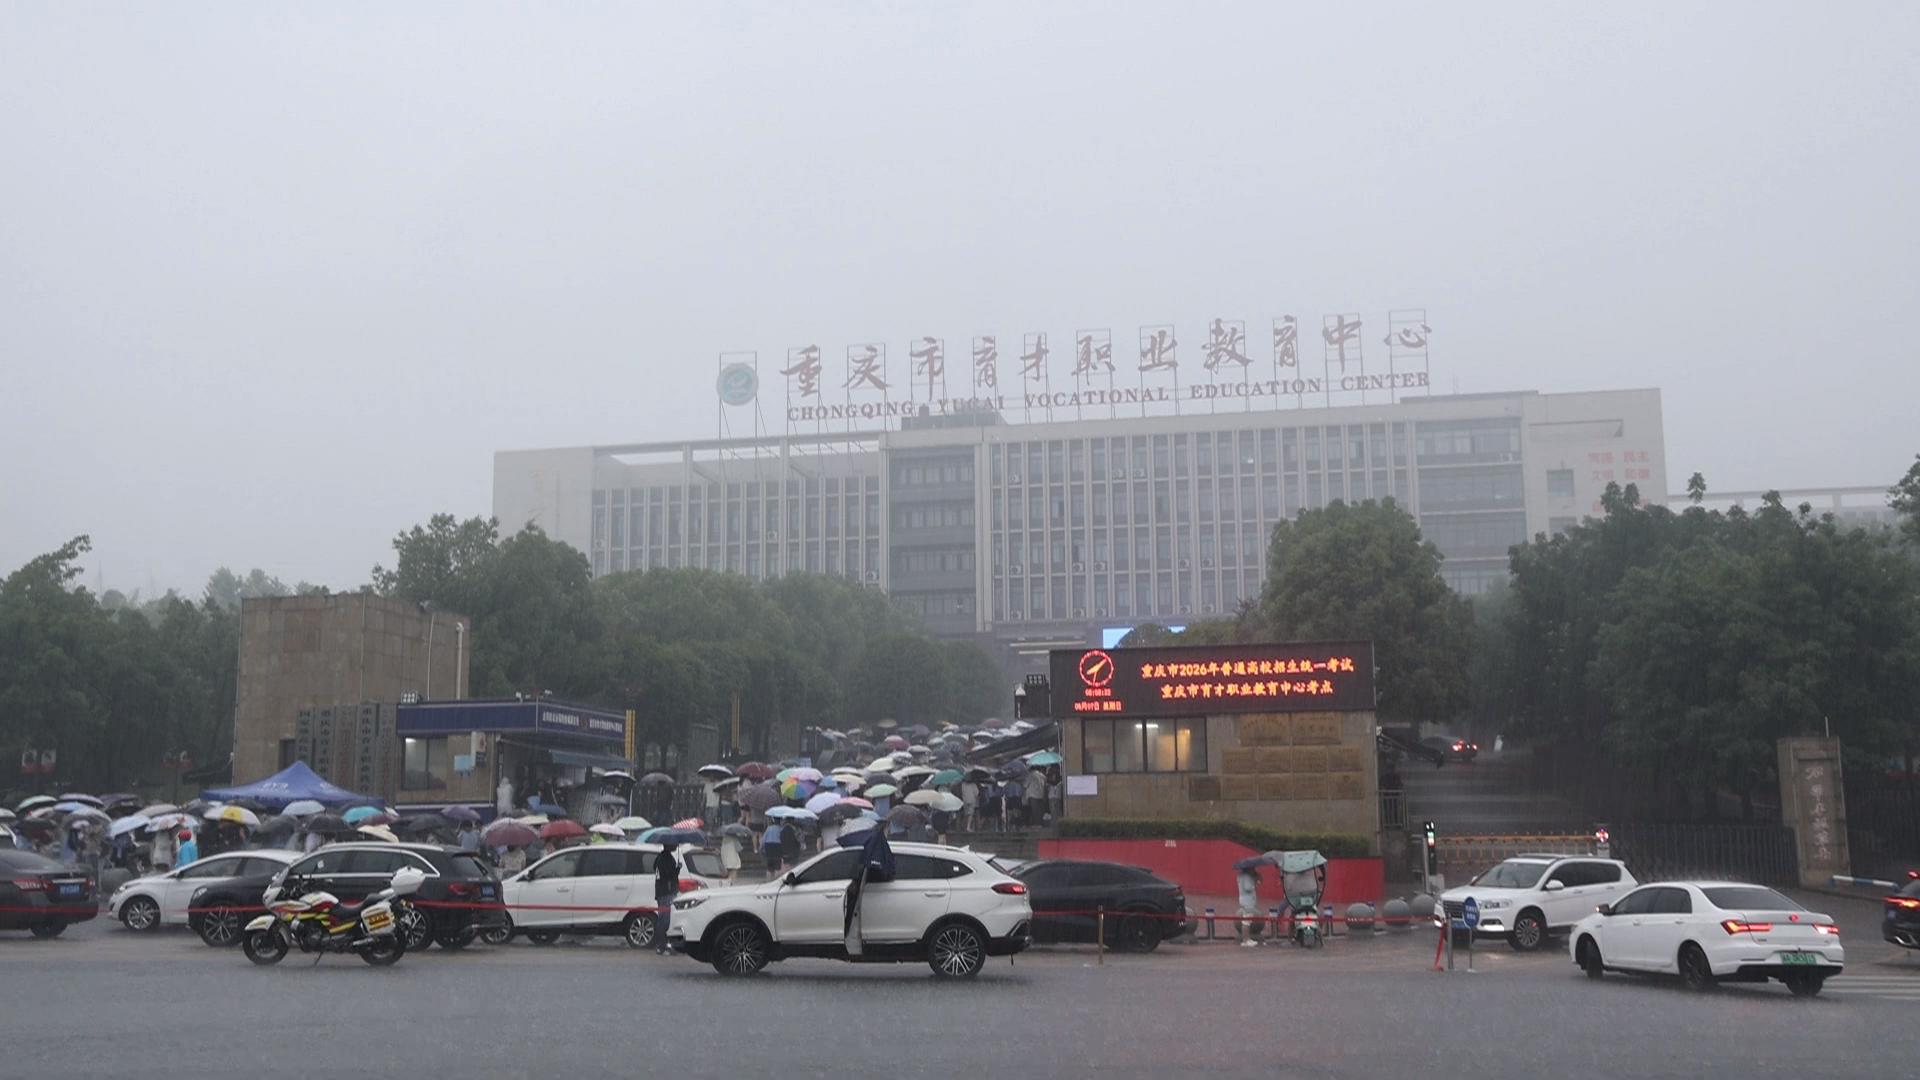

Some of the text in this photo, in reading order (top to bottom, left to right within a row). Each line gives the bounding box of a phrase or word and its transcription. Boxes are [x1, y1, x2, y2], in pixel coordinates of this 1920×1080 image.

[779, 314, 1432, 401] 重庆市育才职业教育中心
[787, 400, 914, 422] CHONGQING
[1024, 385, 1170, 409] VOCATIONAL
[1190, 376, 1322, 400] EDUCATION
[1340, 370, 1431, 392] CENTER
[1141, 657, 1354, 679] 重庆市2026年普通高校招生统一考试
[1160, 680, 1334, 699] 重庆市育才职业教育中心考点
